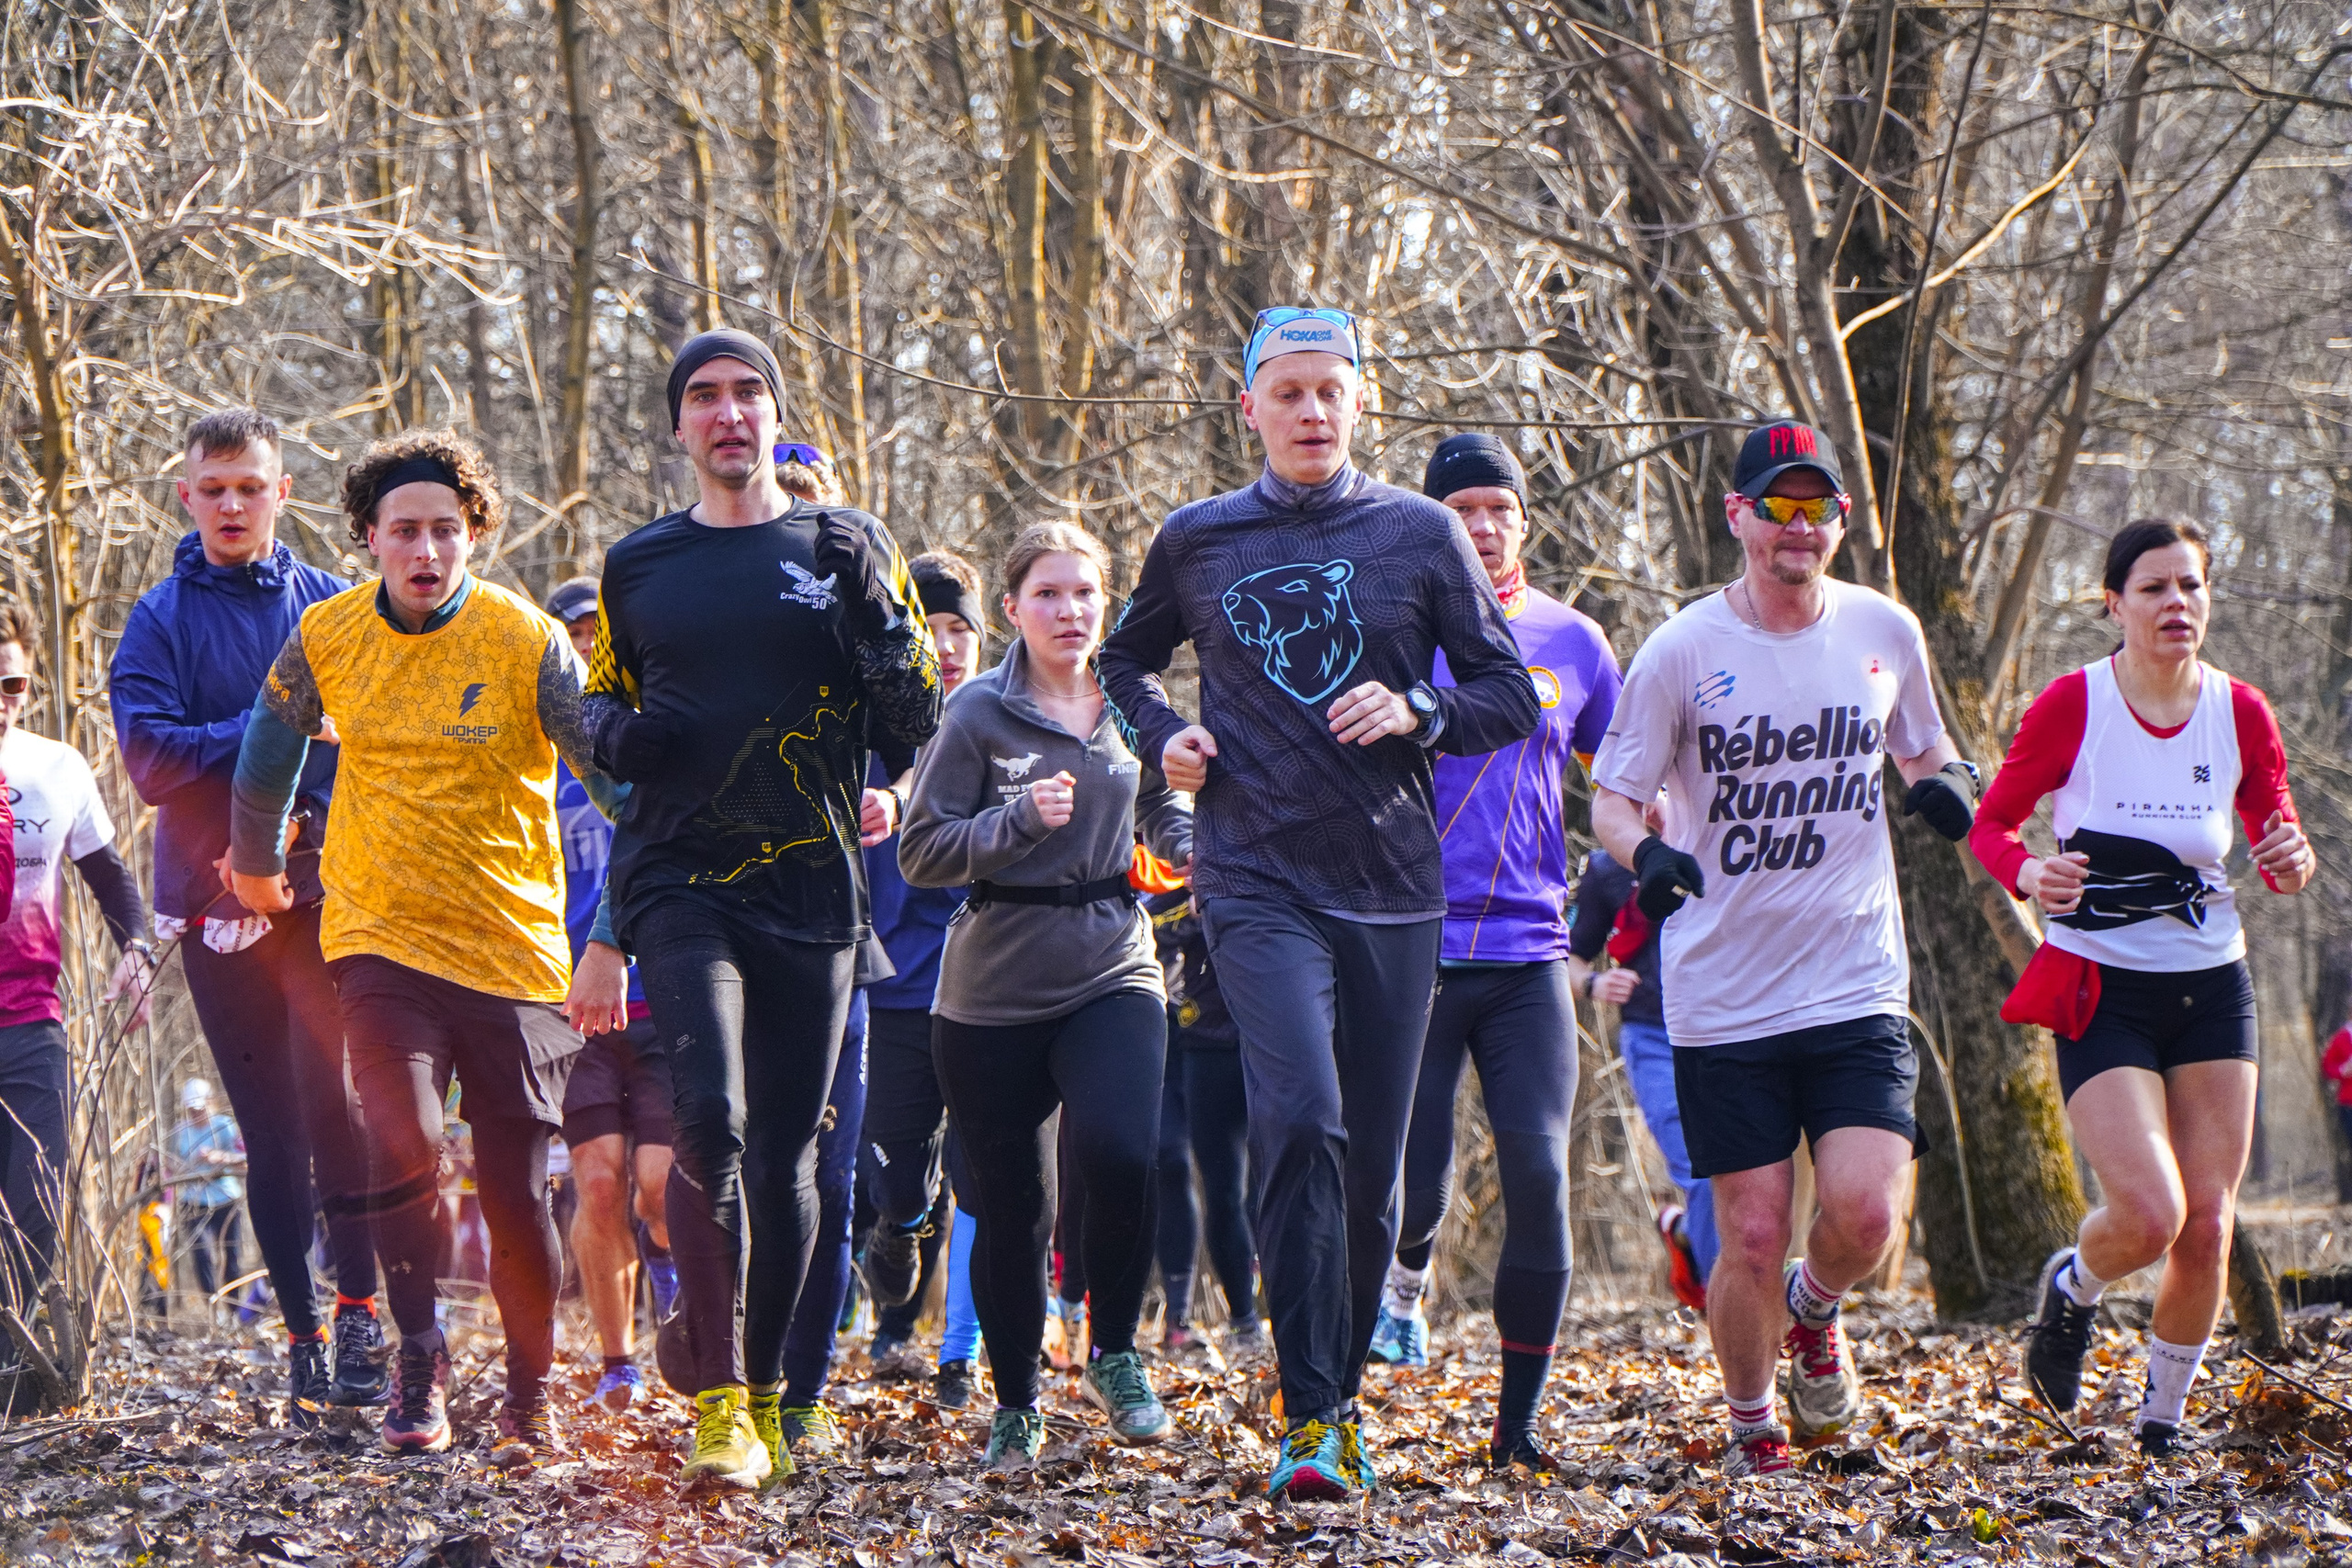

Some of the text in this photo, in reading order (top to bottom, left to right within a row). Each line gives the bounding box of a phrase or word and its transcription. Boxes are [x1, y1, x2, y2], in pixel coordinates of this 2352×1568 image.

[1280, 330, 1317, 342] HOKA
[780, 592, 799, 601] Crazy
[812, 597, 827, 610] 50
[442, 725, 498, 738] ШОКЕР
[453, 737, 487, 745] ГРУППА
[1699, 705, 1882, 773] Rébellio
[997, 784, 1021, 794] MAD
[1708, 761, 1883, 823] Running
[2116, 802, 2213, 812] PIRANHA
[1720, 818, 1826, 876] Club
